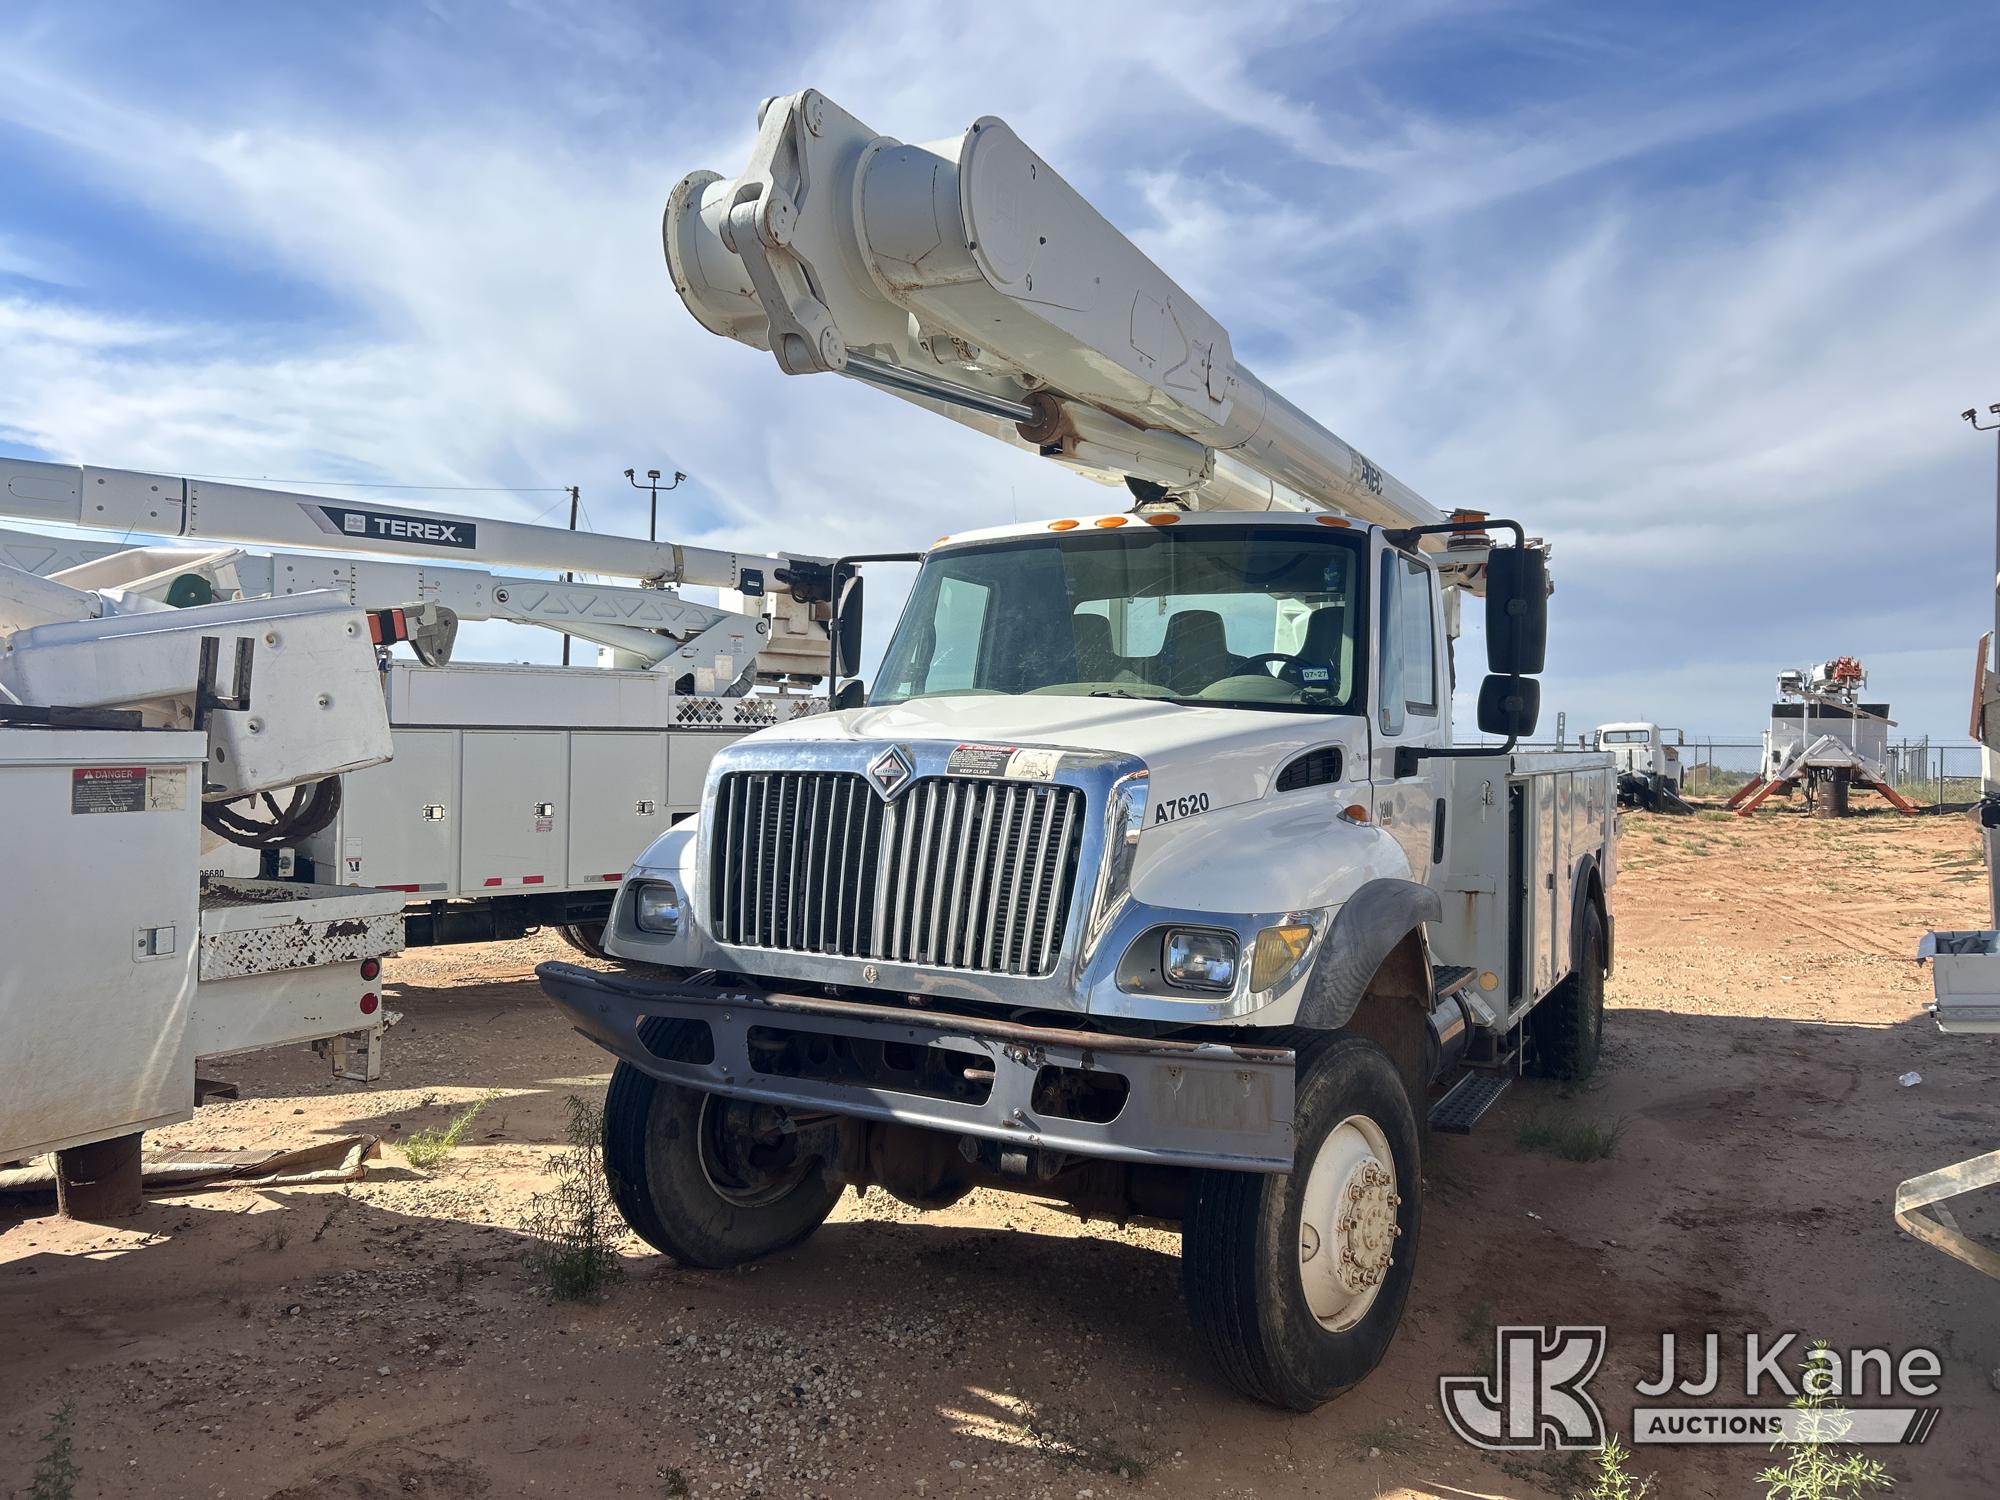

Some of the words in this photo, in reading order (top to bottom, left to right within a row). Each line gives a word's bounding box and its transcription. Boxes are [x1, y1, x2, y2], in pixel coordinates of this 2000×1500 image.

[374, 517, 457, 542] TEREX
[1304, 670, 1327, 678] 07-27
[95, 770, 133, 779] DANGER
[1155, 792, 1210, 825] A7620
